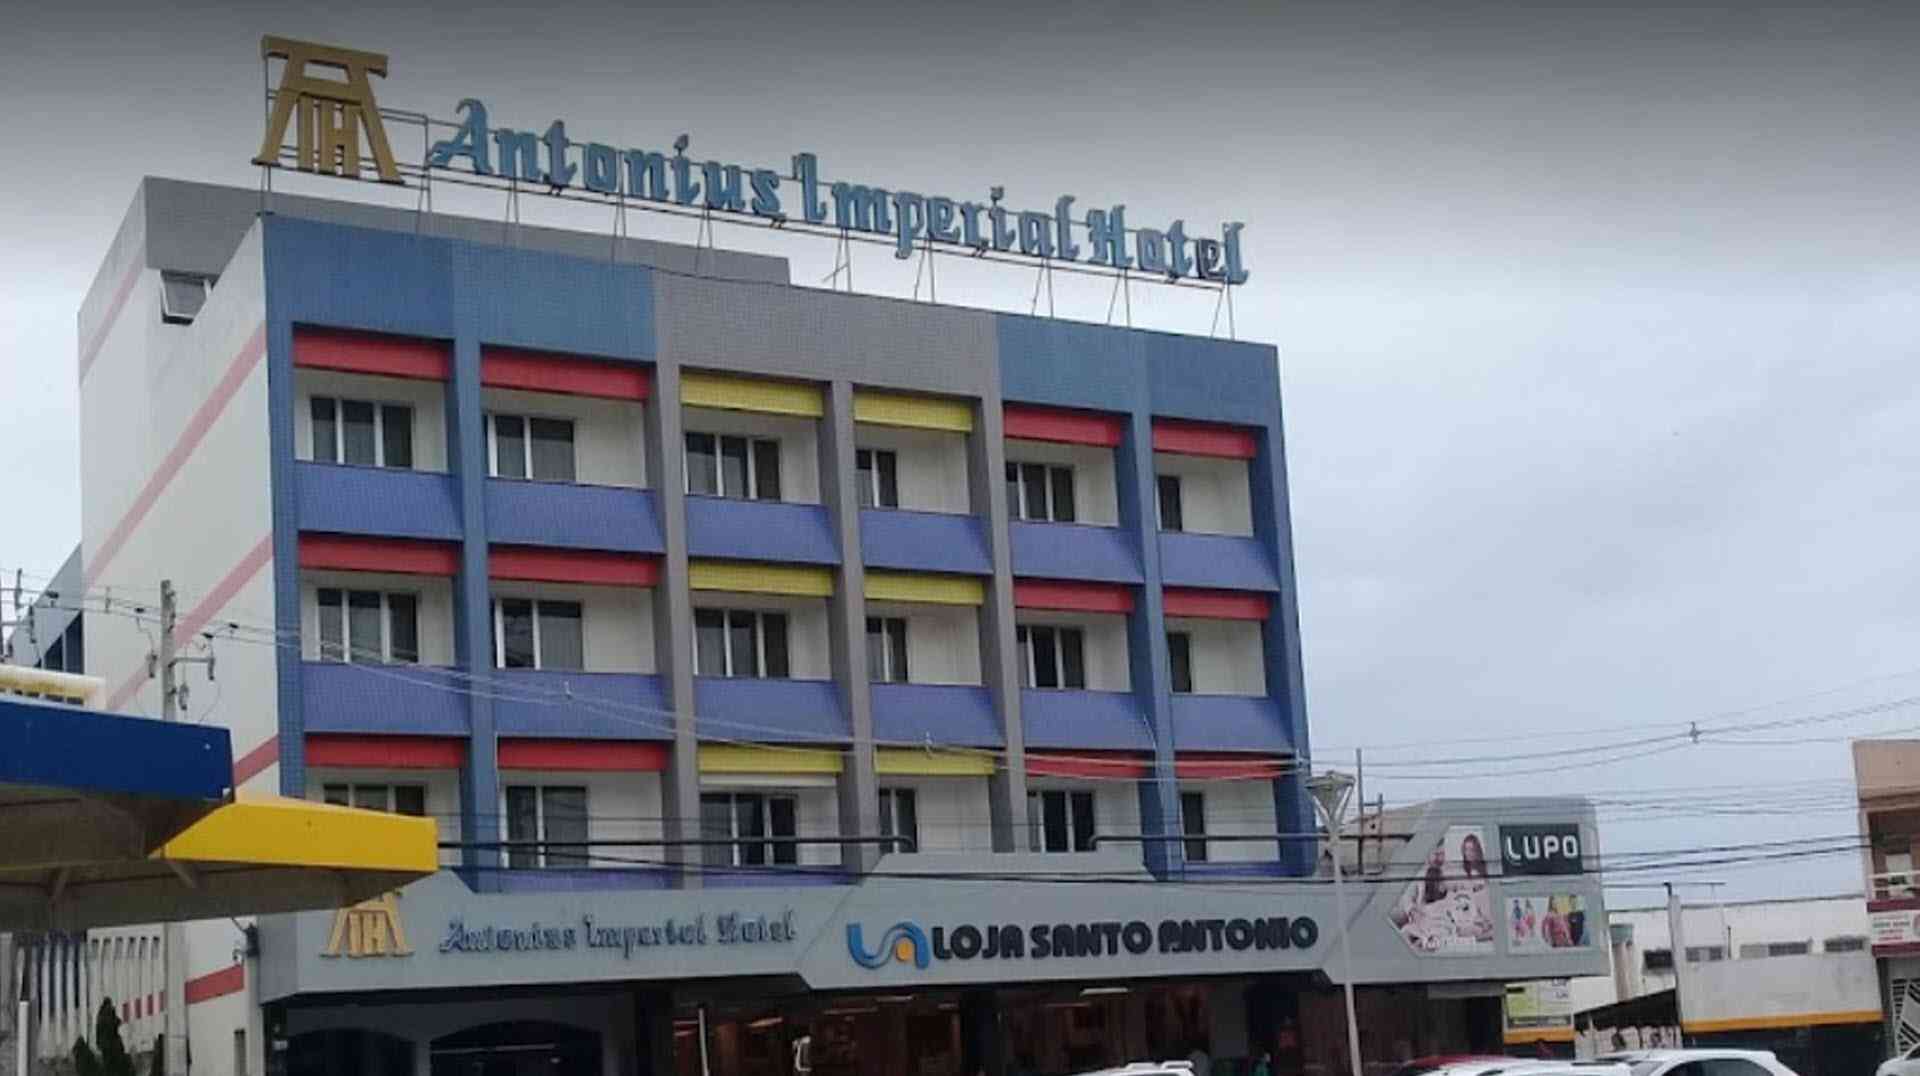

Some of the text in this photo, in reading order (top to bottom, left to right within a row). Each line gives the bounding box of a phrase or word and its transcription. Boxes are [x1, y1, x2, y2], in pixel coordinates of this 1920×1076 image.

[427, 98, 1249, 286] Antonius Imperial Hotel
[1506, 835, 1580, 860] LUPO
[932, 923, 1025, 961] LOJA
[1029, 920, 1154, 960] SANTO
[1157, 916, 1319, 955] ANTONIO
